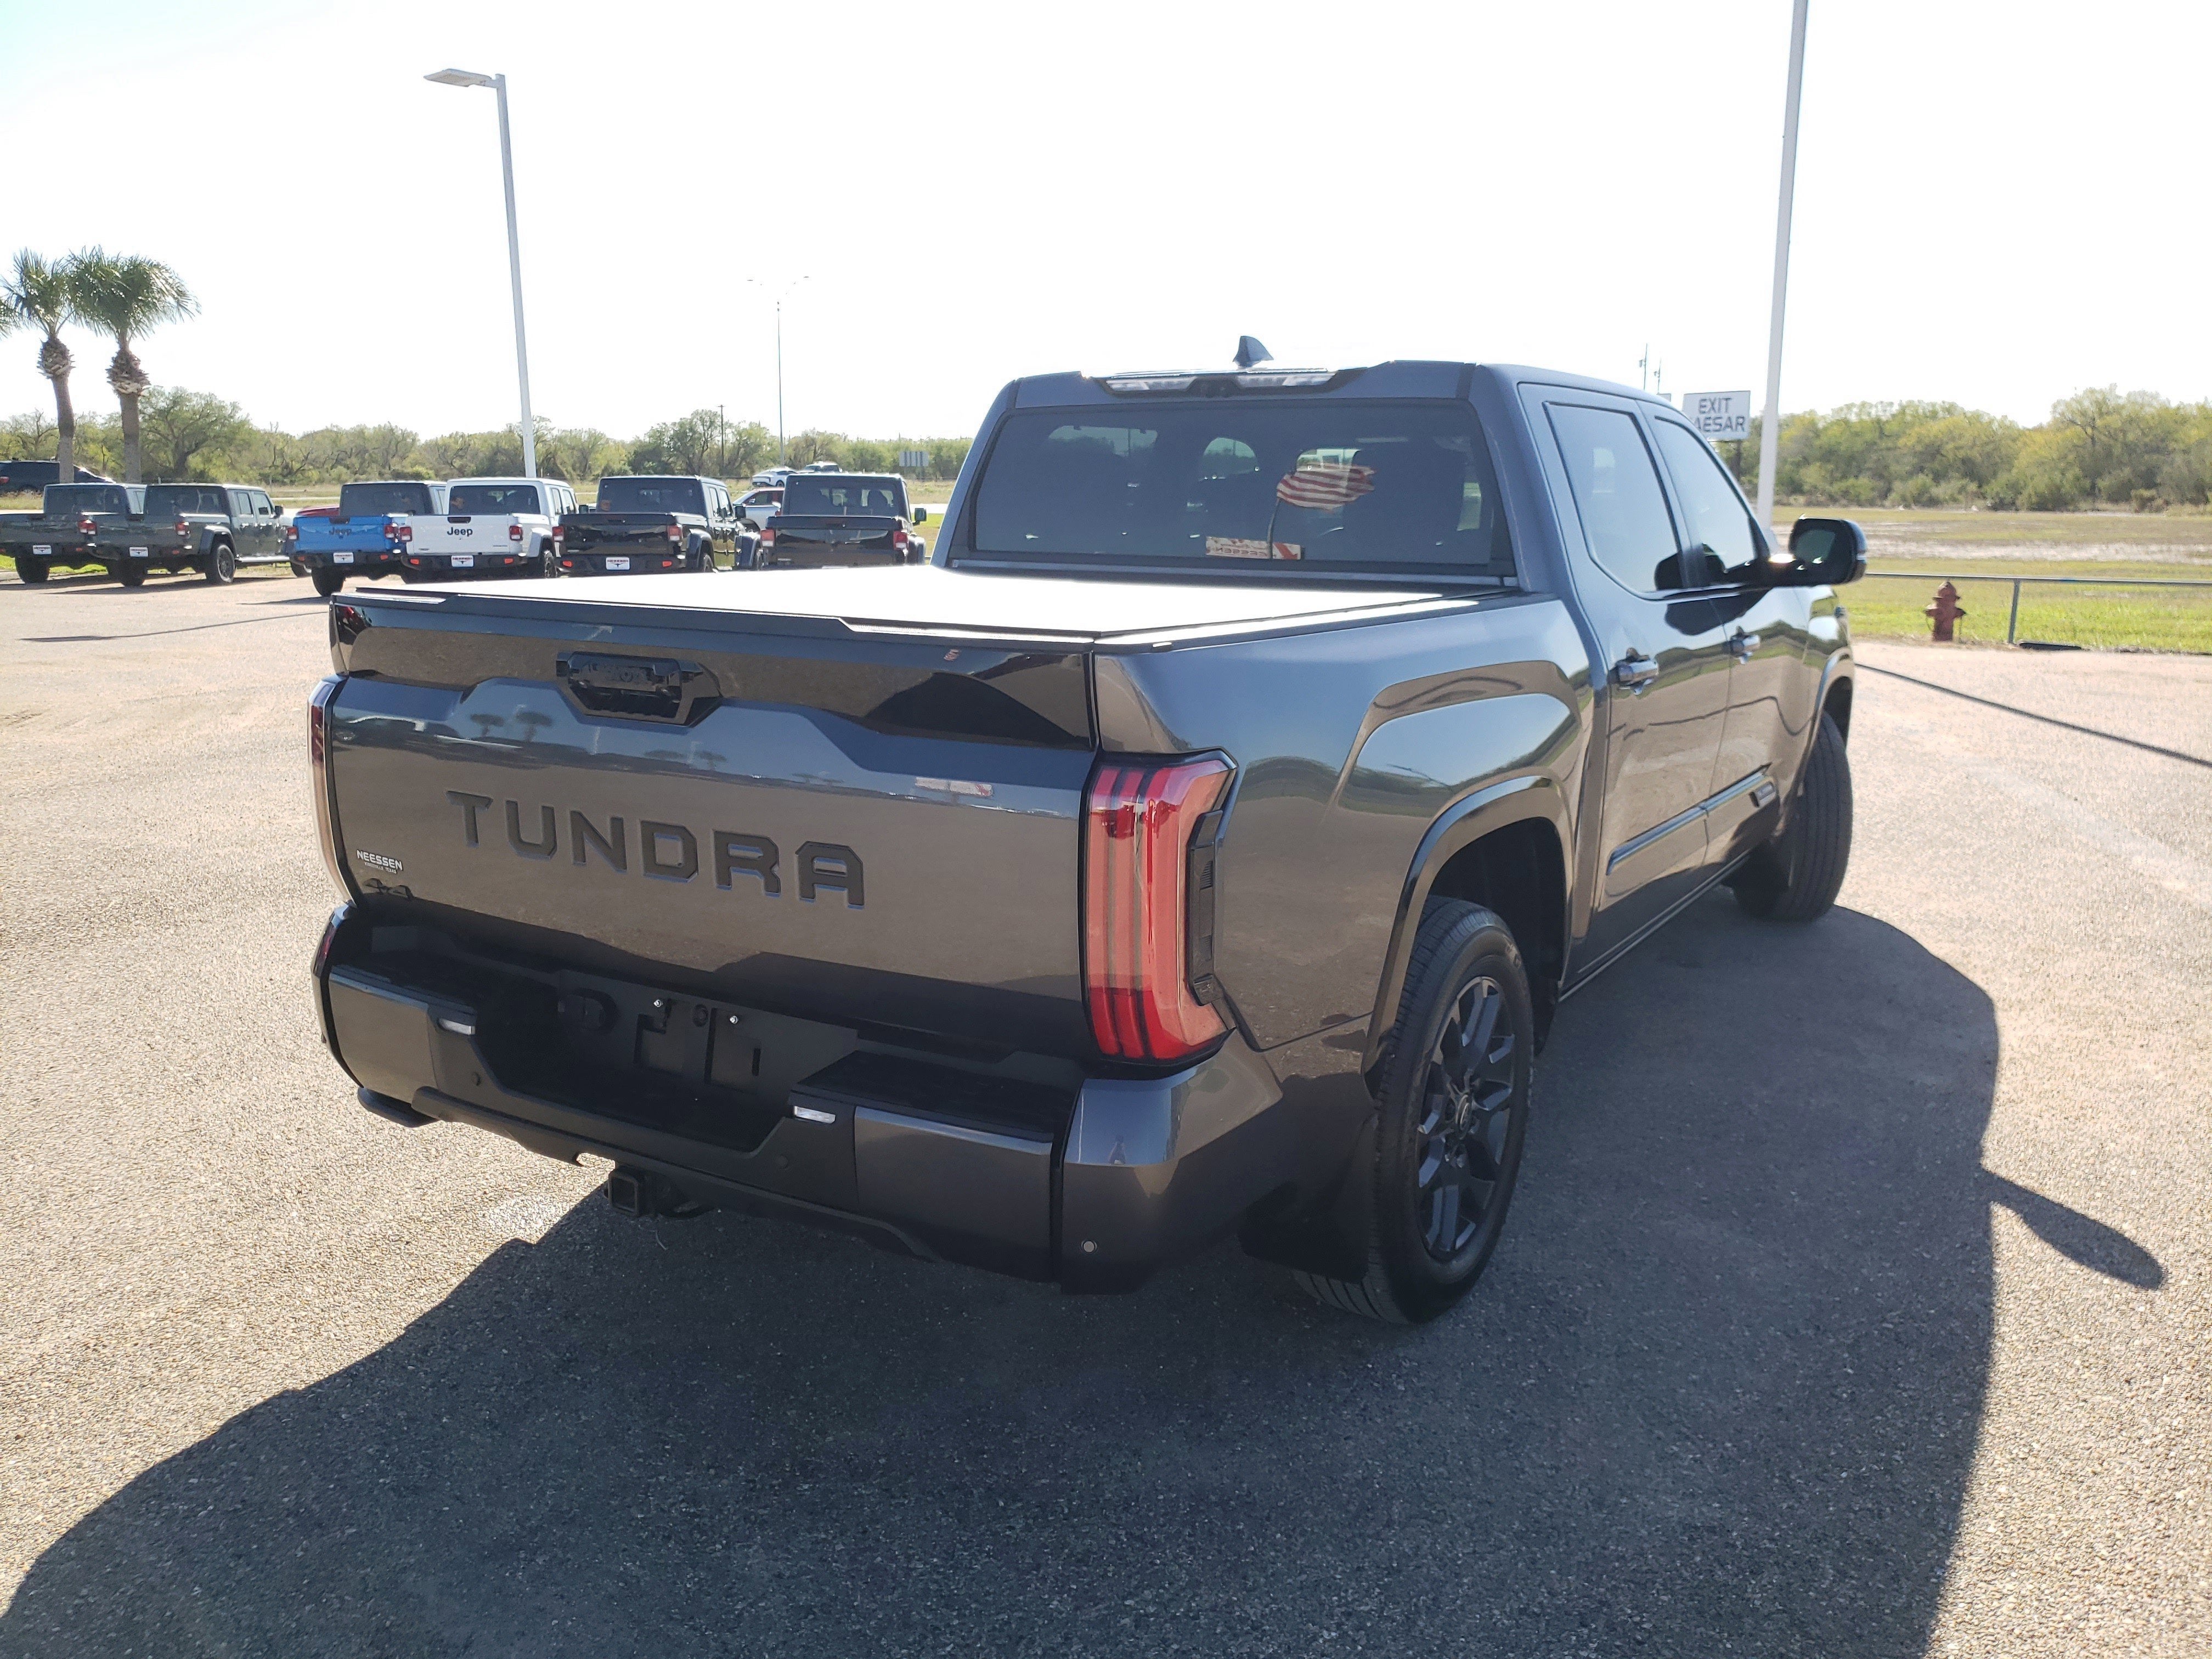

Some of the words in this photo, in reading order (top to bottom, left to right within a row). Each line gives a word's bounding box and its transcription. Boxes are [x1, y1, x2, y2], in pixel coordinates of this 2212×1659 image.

[1699, 397, 1732, 414] EXIT
[1691, 416, 1746, 432] AESAR
[447, 527, 473, 537] Jeep
[445, 790, 865, 909] TUNDRA
[357, 849, 403, 871] NEESSEN
